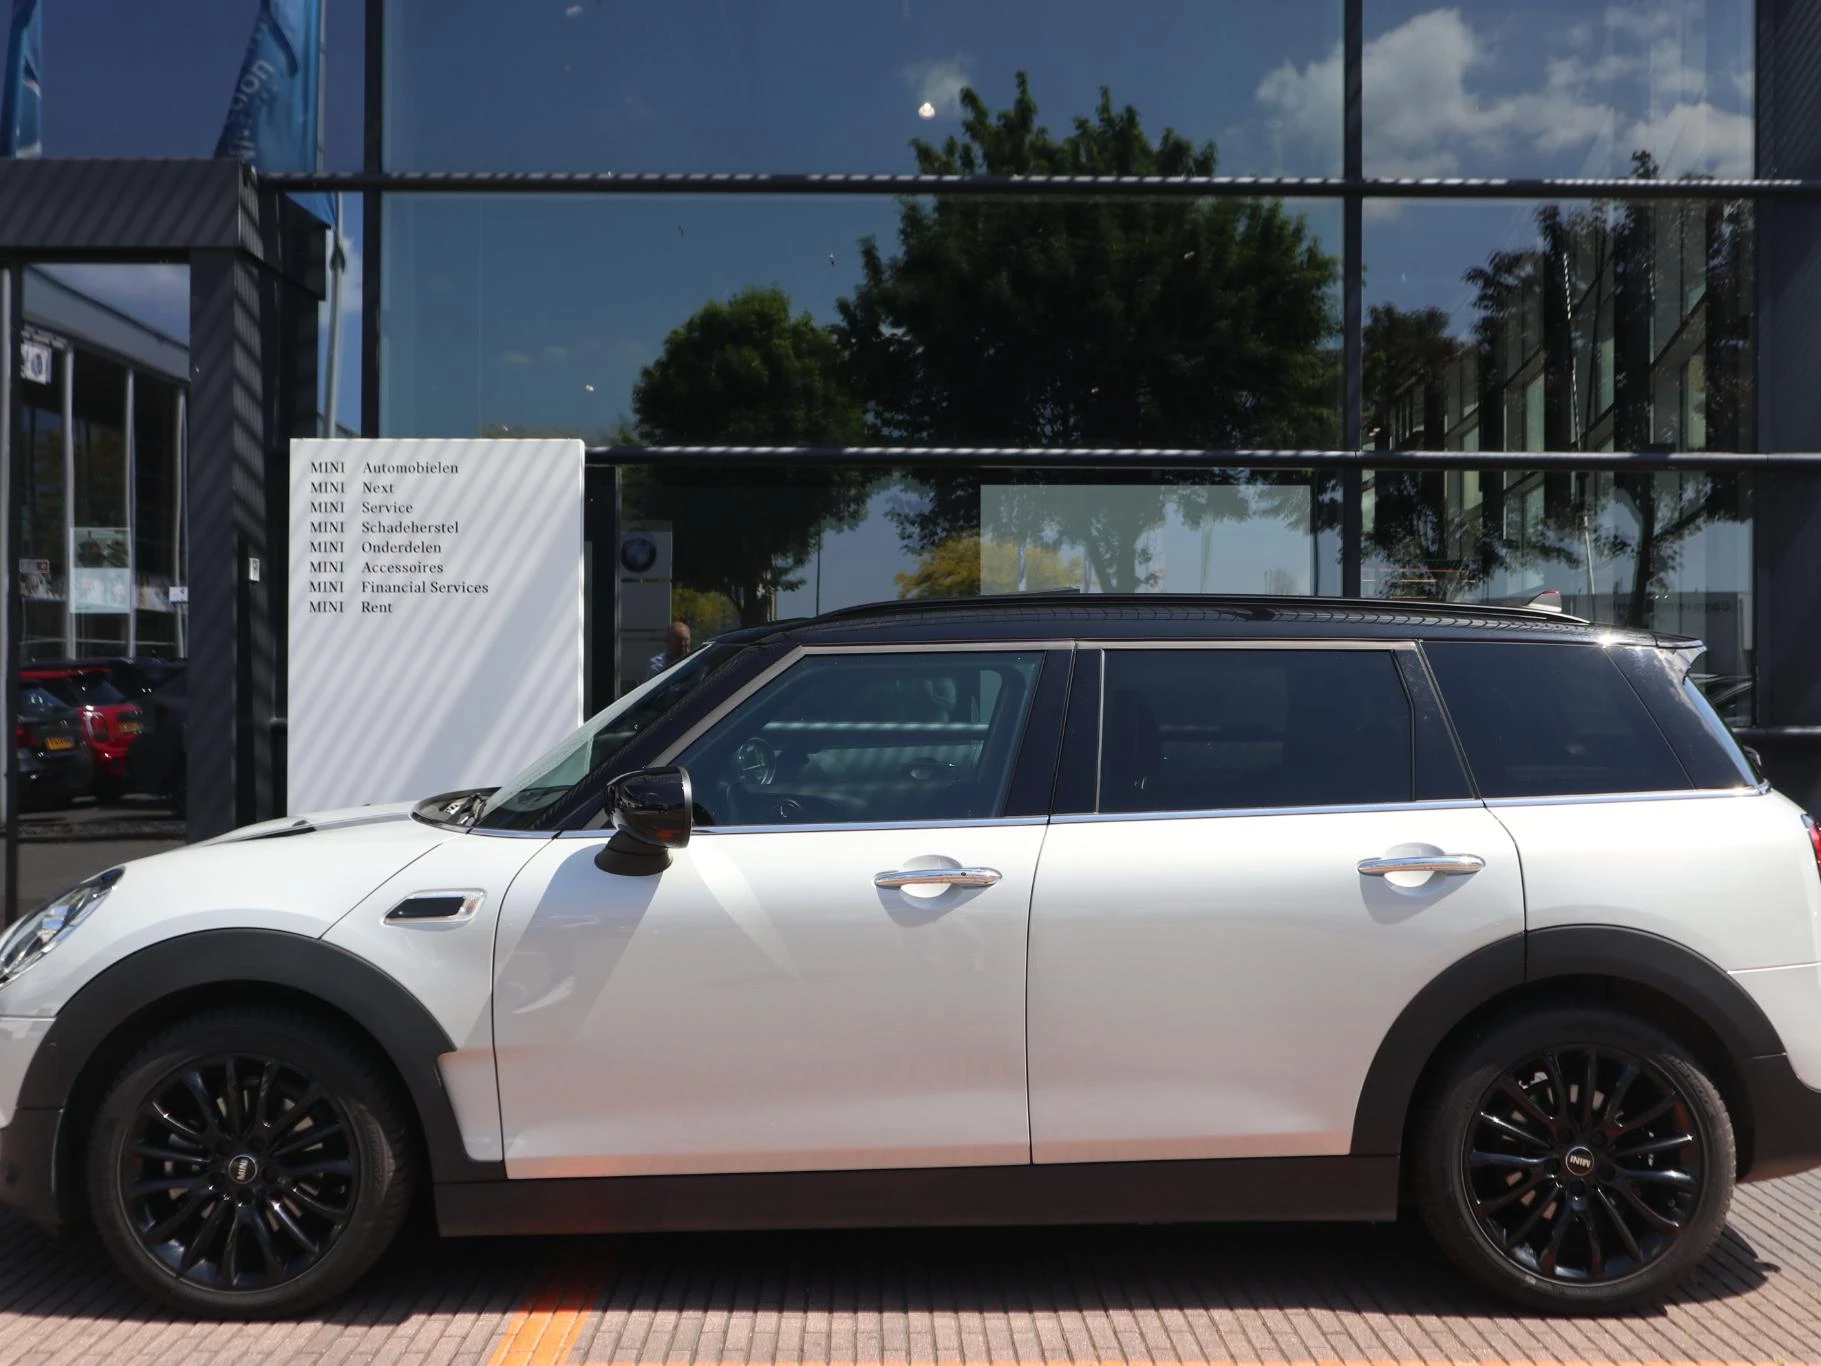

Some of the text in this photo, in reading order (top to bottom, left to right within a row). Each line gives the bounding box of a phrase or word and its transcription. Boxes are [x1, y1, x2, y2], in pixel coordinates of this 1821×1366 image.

[311, 460, 459, 474] MINI Automobielen
[311, 481, 395, 493] MINI Next
[310, 500, 413, 513] MINI Service
[310, 520, 459, 533] MINI Schadeherstel
[310, 540, 442, 553] MINI Onderdelen
[310, 560, 444, 573] MINI Accessoires
[309, 580, 489, 593] MINI Financial Services
[309, 600, 393, 613] MINI Rent
[1570, 1155, 1591, 1168] MINI
[236, 1159, 249, 1181] MINI
